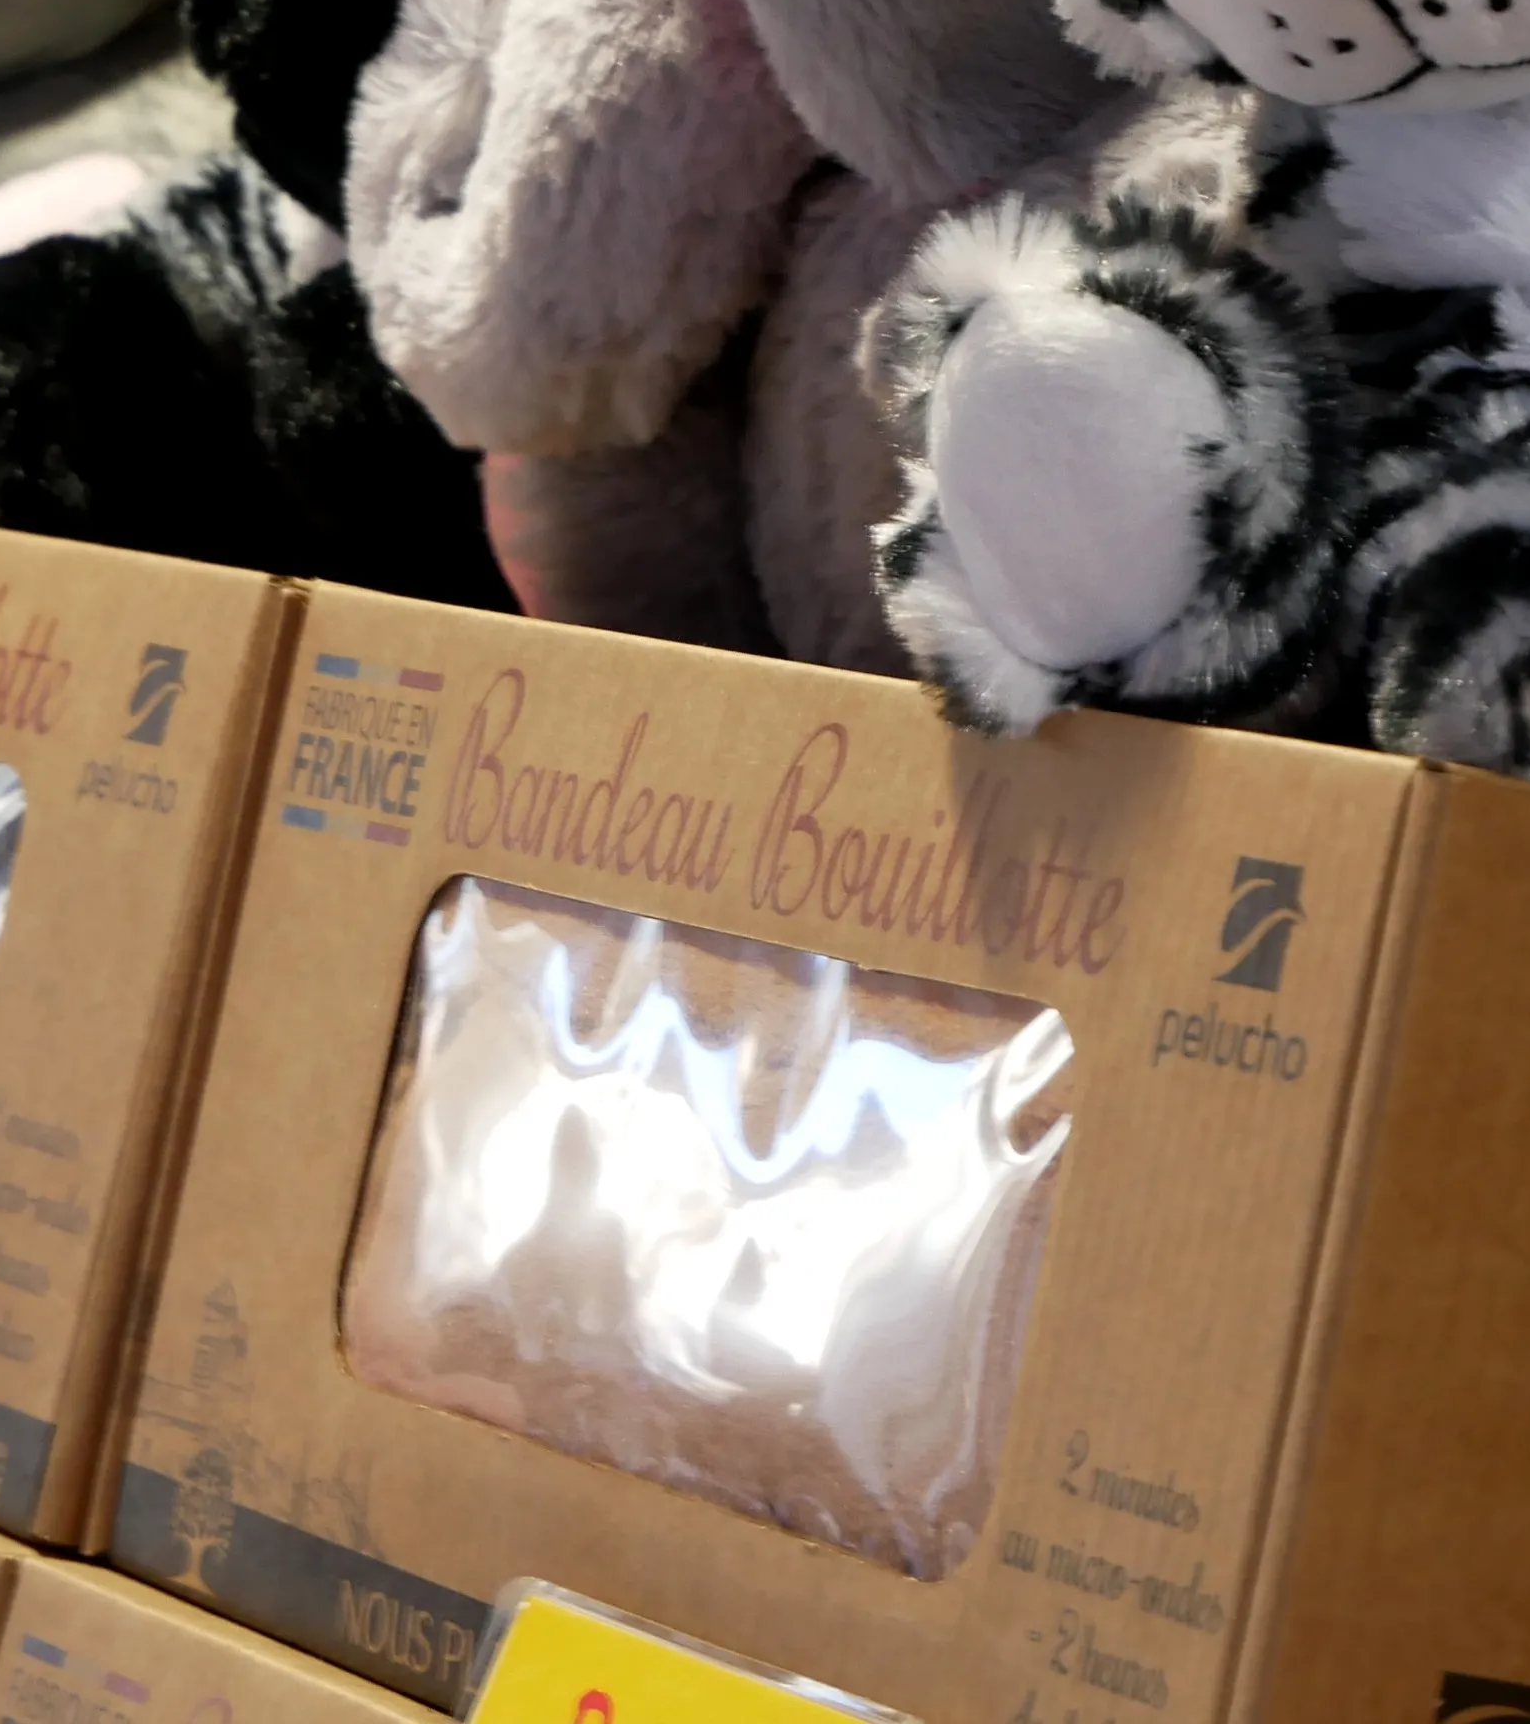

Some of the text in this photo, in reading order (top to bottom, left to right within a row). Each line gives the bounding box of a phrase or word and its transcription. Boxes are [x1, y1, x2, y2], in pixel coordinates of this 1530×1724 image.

[405, 703, 439, 750] EN
[77, 754, 180, 816] pelucho
[289, 731, 427, 818] FRANCE
[444, 668, 1128, 977] Bandeau Bouillotte
[1152, 1001, 1308, 1082] pelucho
[1057, 1429, 1090, 1497] 2
[337, 1578, 434, 1673] NOUS
[1049, 1607, 1080, 1676] 2
